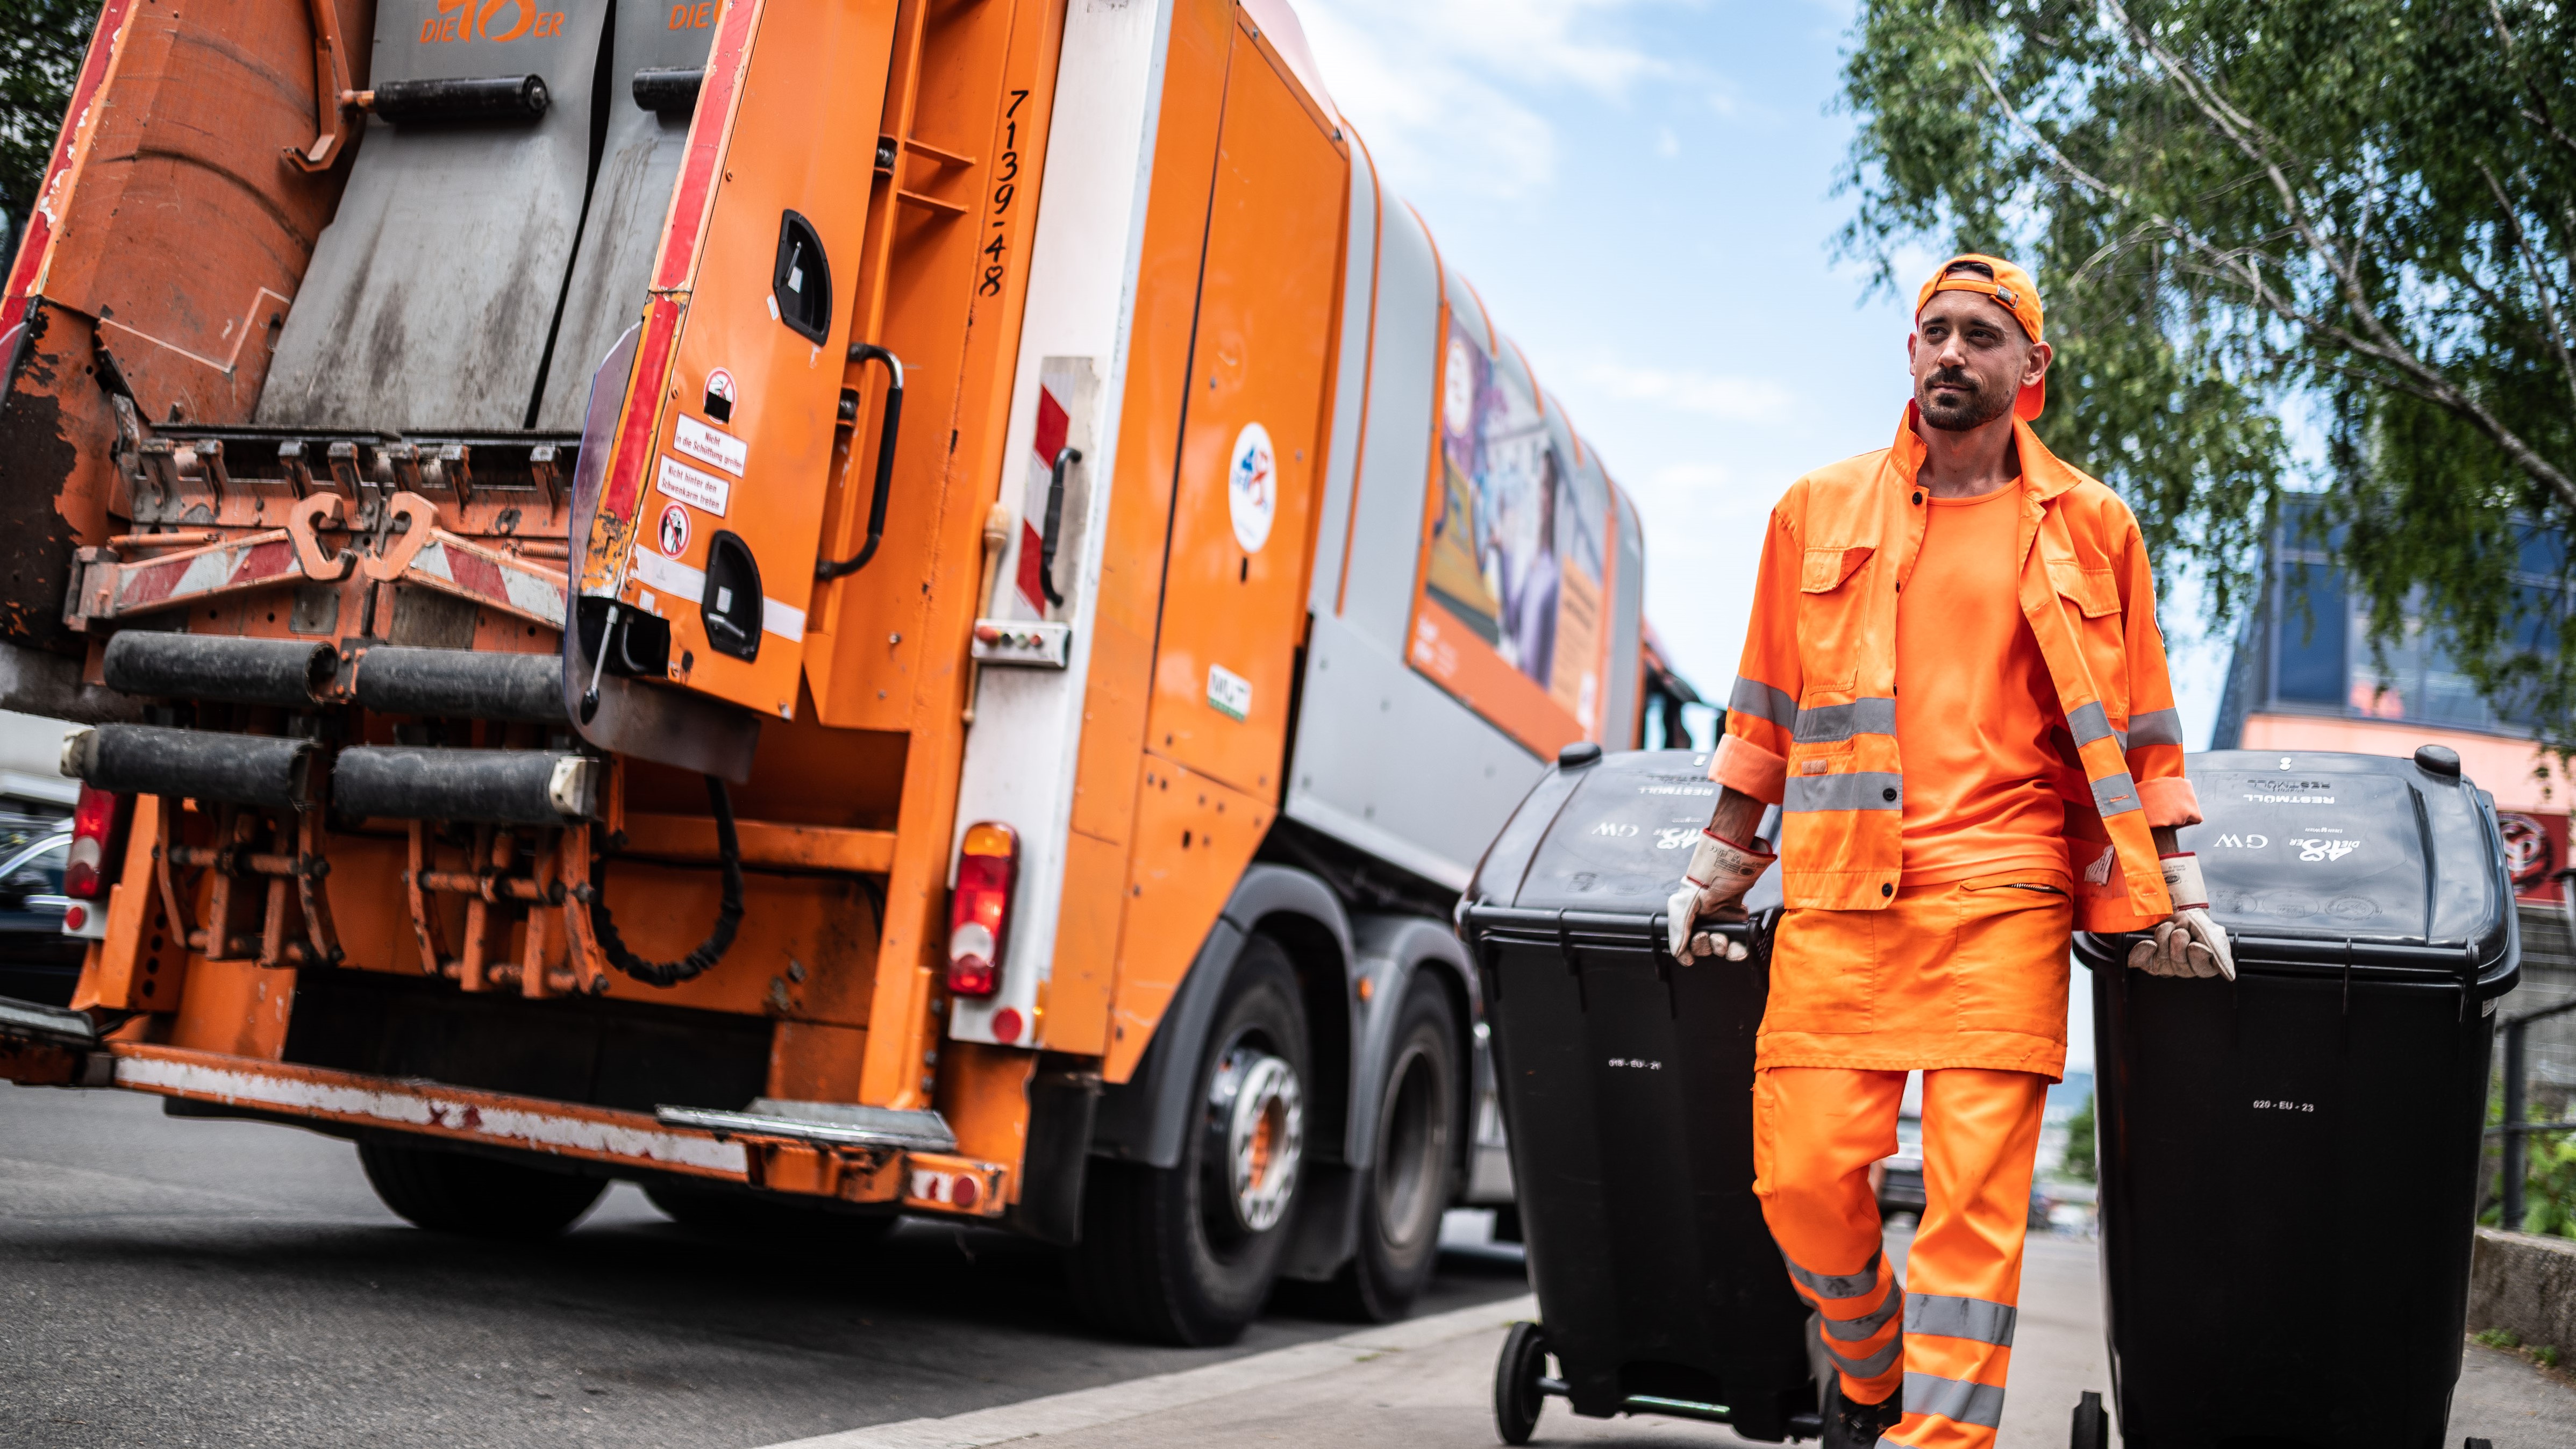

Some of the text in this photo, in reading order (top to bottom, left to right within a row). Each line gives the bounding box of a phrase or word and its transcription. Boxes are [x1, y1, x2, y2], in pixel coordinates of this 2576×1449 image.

[419, 17, 457, 44] DIE
[978, 89, 1029, 297] 7139-48
[705, 432, 721, 447] Nicht
[676, 433, 743, 469] in die Schüttung greifen
[668, 465, 717, 494] Nicht hinter den
[661, 478, 720, 510] Schwenkarm treten
[2243, 794, 2335, 804] RESTMÜLL
[2213, 833, 2269, 849] GW
[1630, 1058, 1645, 1068] EU
[2253, 1100, 2271, 1109] 020
[2279, 1101, 2293, 1110] EU
[2302, 1103, 2314, 1112] 23
